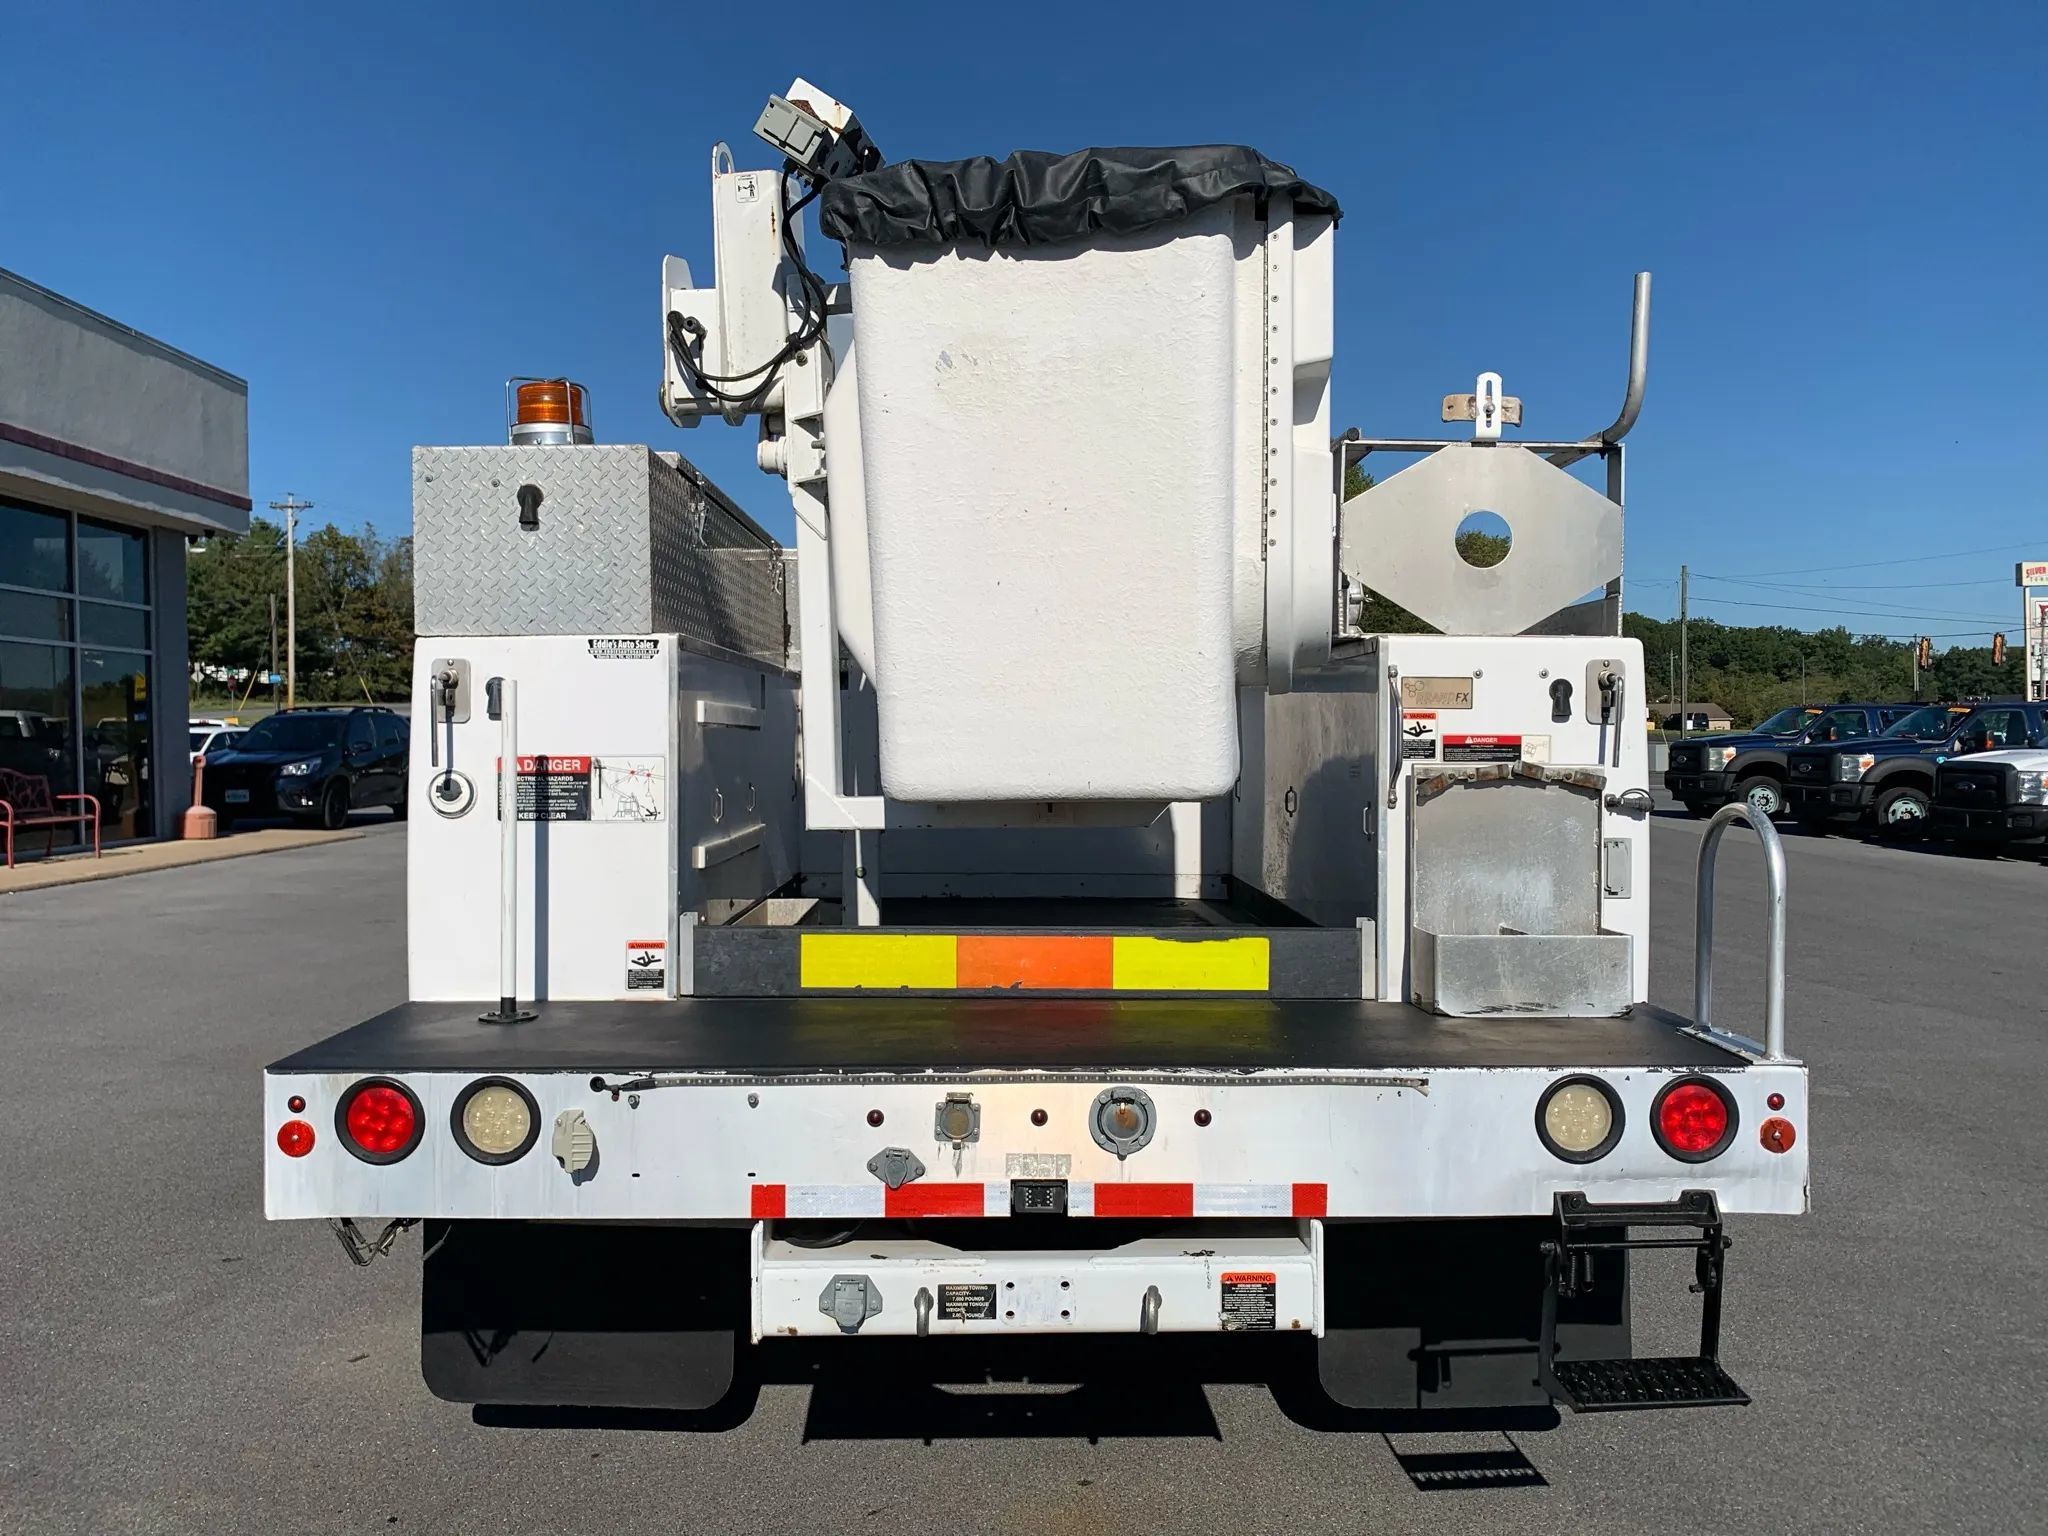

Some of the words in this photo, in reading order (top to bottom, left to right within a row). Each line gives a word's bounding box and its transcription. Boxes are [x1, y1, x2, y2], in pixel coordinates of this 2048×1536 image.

[593, 639, 618, 649] Eddie's
[618, 639, 635, 649] Auto
[635, 639, 654, 649] Sales
[524, 759, 581, 771] DANGER
[518, 812, 539, 820] KEEP
[540, 812, 567, 820] CLEAR
[1234, 1274, 1272, 1282] WARNING
